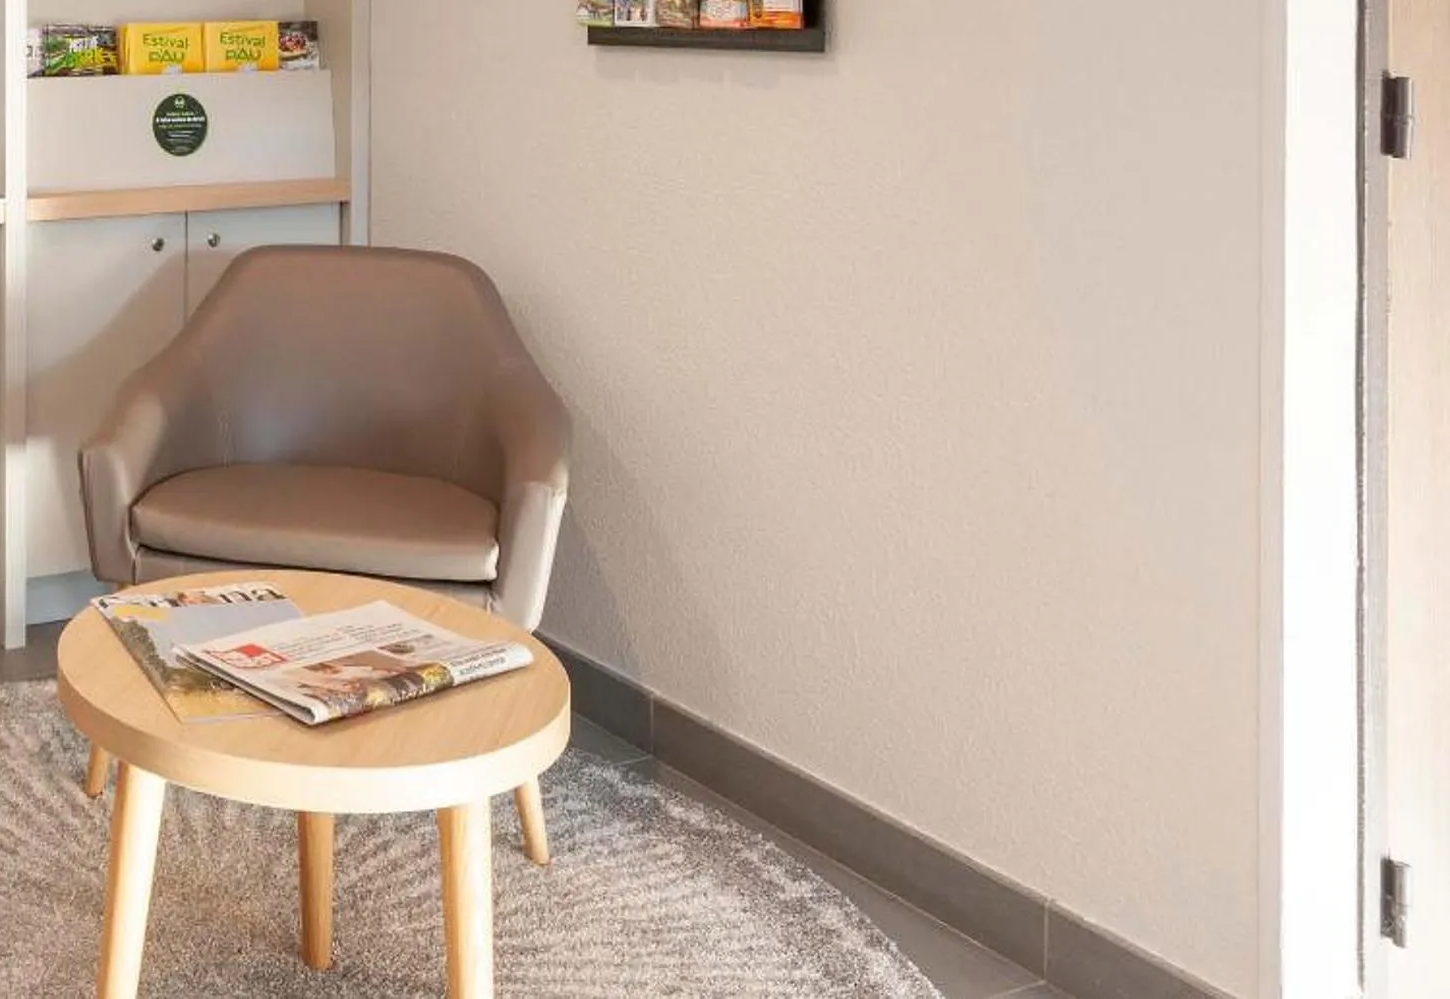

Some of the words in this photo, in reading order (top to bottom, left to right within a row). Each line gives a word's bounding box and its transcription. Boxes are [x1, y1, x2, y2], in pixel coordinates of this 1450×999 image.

[142, 33, 190, 49] Estival
[219, 31, 266, 48] Estival
[148, 49, 185, 64] PAU
[225, 47, 262, 62] PAU
